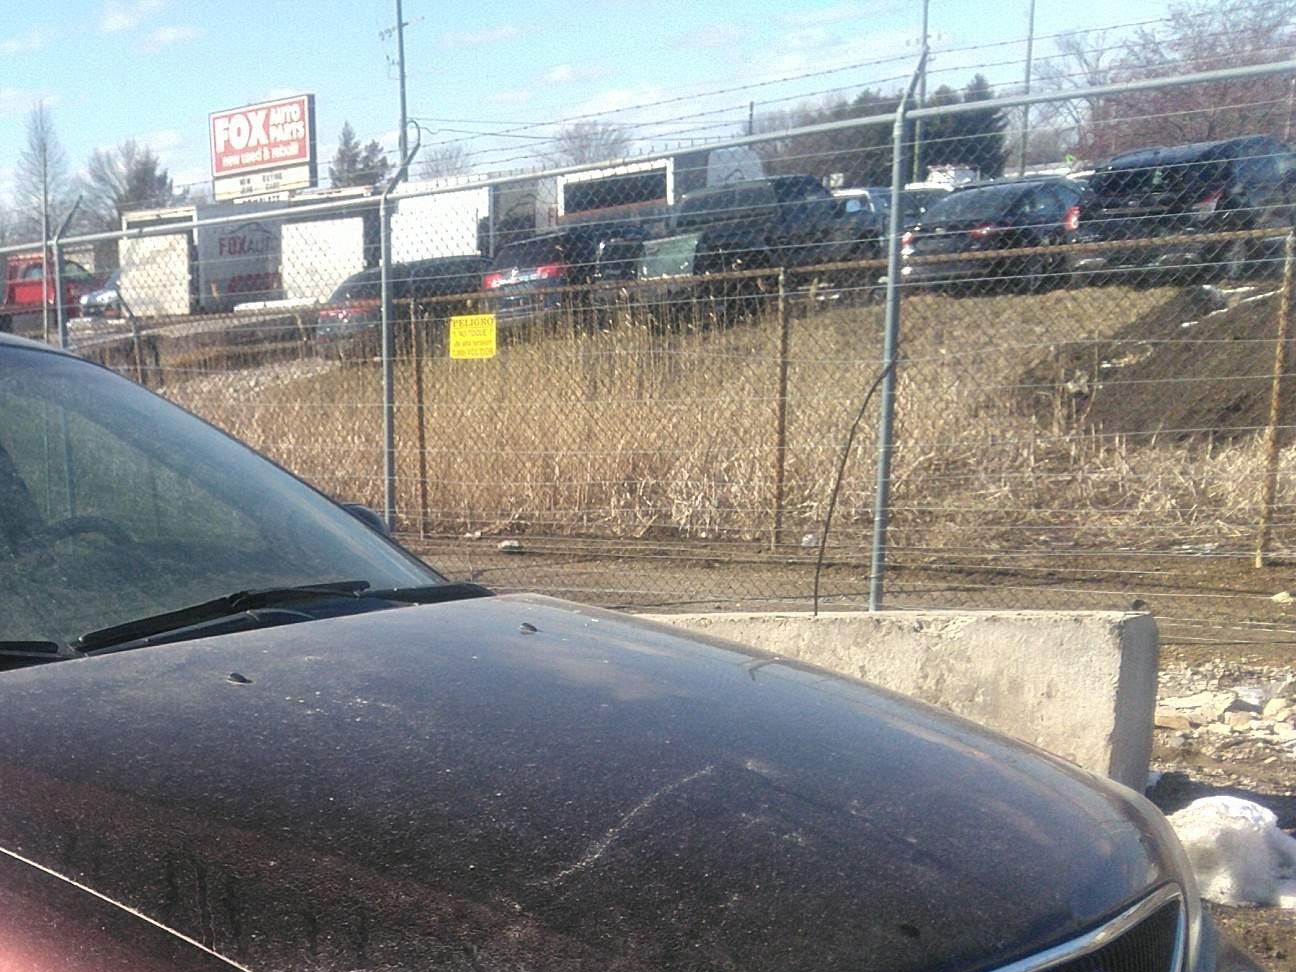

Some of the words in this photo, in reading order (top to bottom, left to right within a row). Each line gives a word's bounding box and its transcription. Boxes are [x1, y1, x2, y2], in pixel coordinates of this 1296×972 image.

[270, 103, 301, 124] AUTO
[215, 108, 269, 153] FOX
[270, 121, 305, 142] PARTS
[452, 317, 494, 328] PELIGRO
